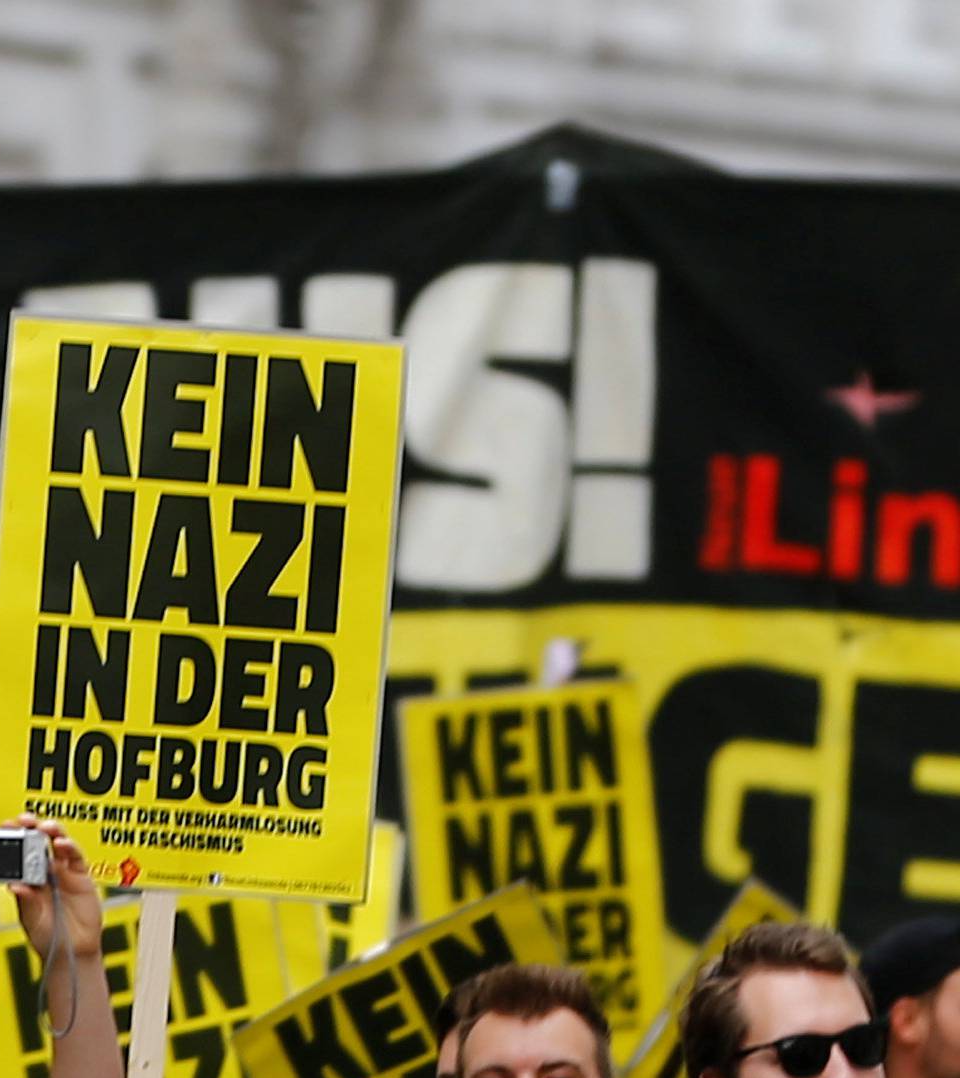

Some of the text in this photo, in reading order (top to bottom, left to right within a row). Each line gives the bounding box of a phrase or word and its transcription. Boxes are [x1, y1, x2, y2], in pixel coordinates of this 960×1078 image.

[50, 341, 357, 493] KEIN
[40, 486, 346, 633] NAZI
[32, 625, 334, 736] IN DER
[27, 727, 328, 810] HOFBURG
[436, 700, 617, 803] KEIN
[25, 800, 322, 837] SCHLUSS MIT DER VERHARMLOSUNG
[101, 828, 244, 854] VON FASCHISMUS
[445, 800, 626, 902] NAZI
[547, 901, 632, 962] ER
